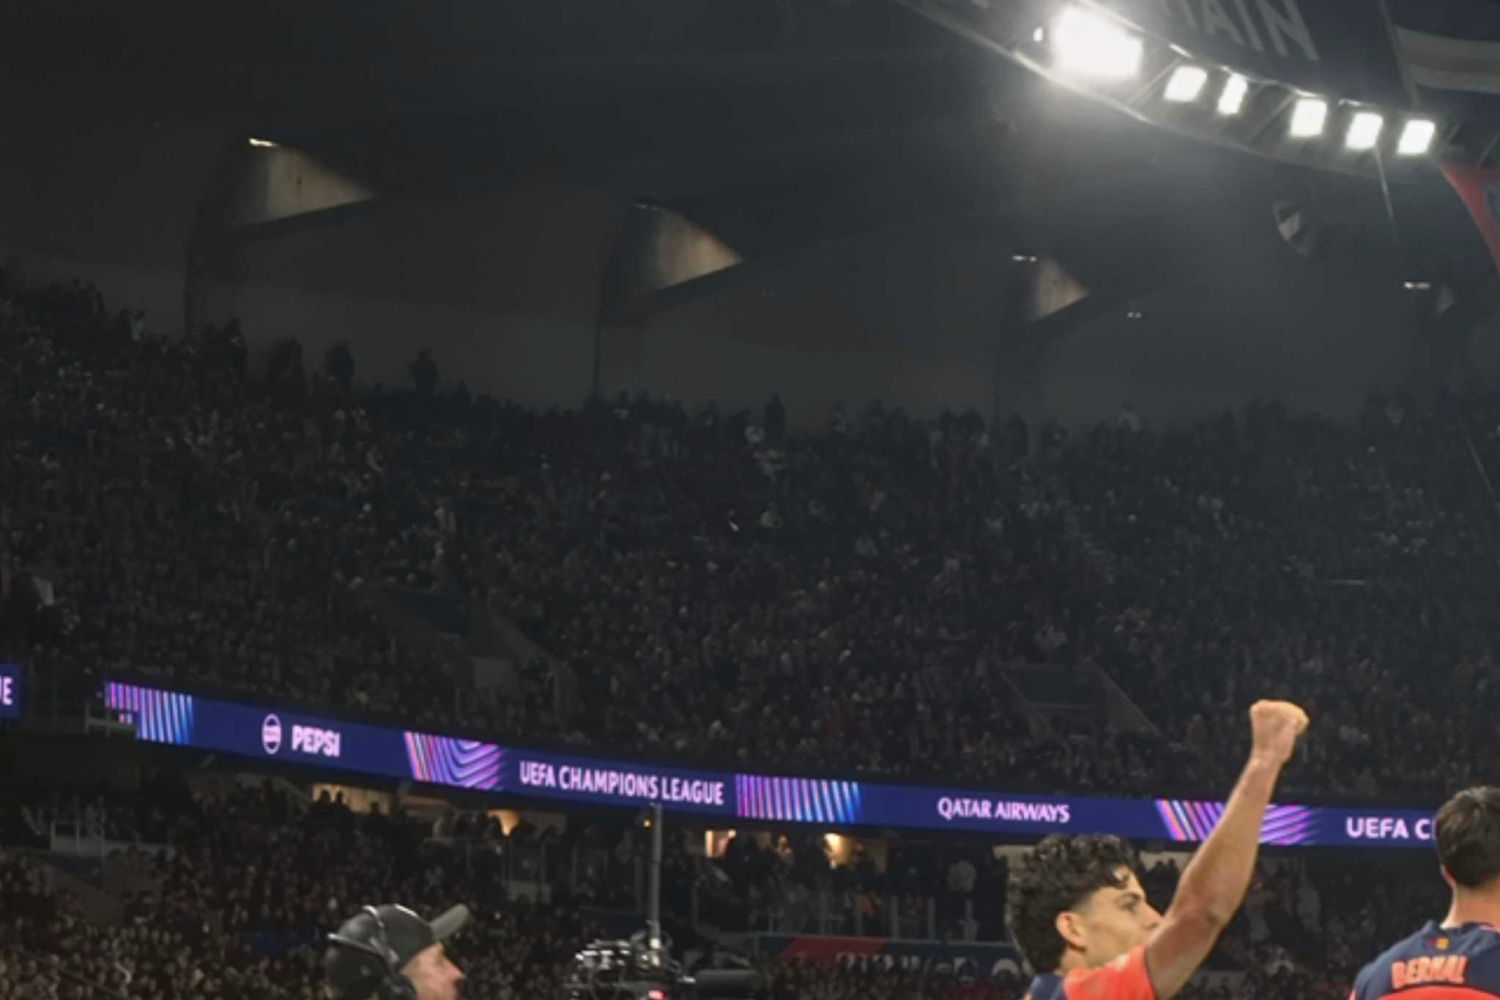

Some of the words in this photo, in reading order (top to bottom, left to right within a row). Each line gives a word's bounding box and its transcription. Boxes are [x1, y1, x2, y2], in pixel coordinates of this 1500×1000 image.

[291, 725, 341, 757] PEPSI
[519, 760, 556, 788] UEFA
[558, 766, 658, 798] CHAMPIONS
[661, 777, 724, 805] LEAGUE
[937, 796, 992, 821] QATAR
[995, 801, 1071, 823] AIRWAYS
[1346, 816, 1409, 840] UEFA
